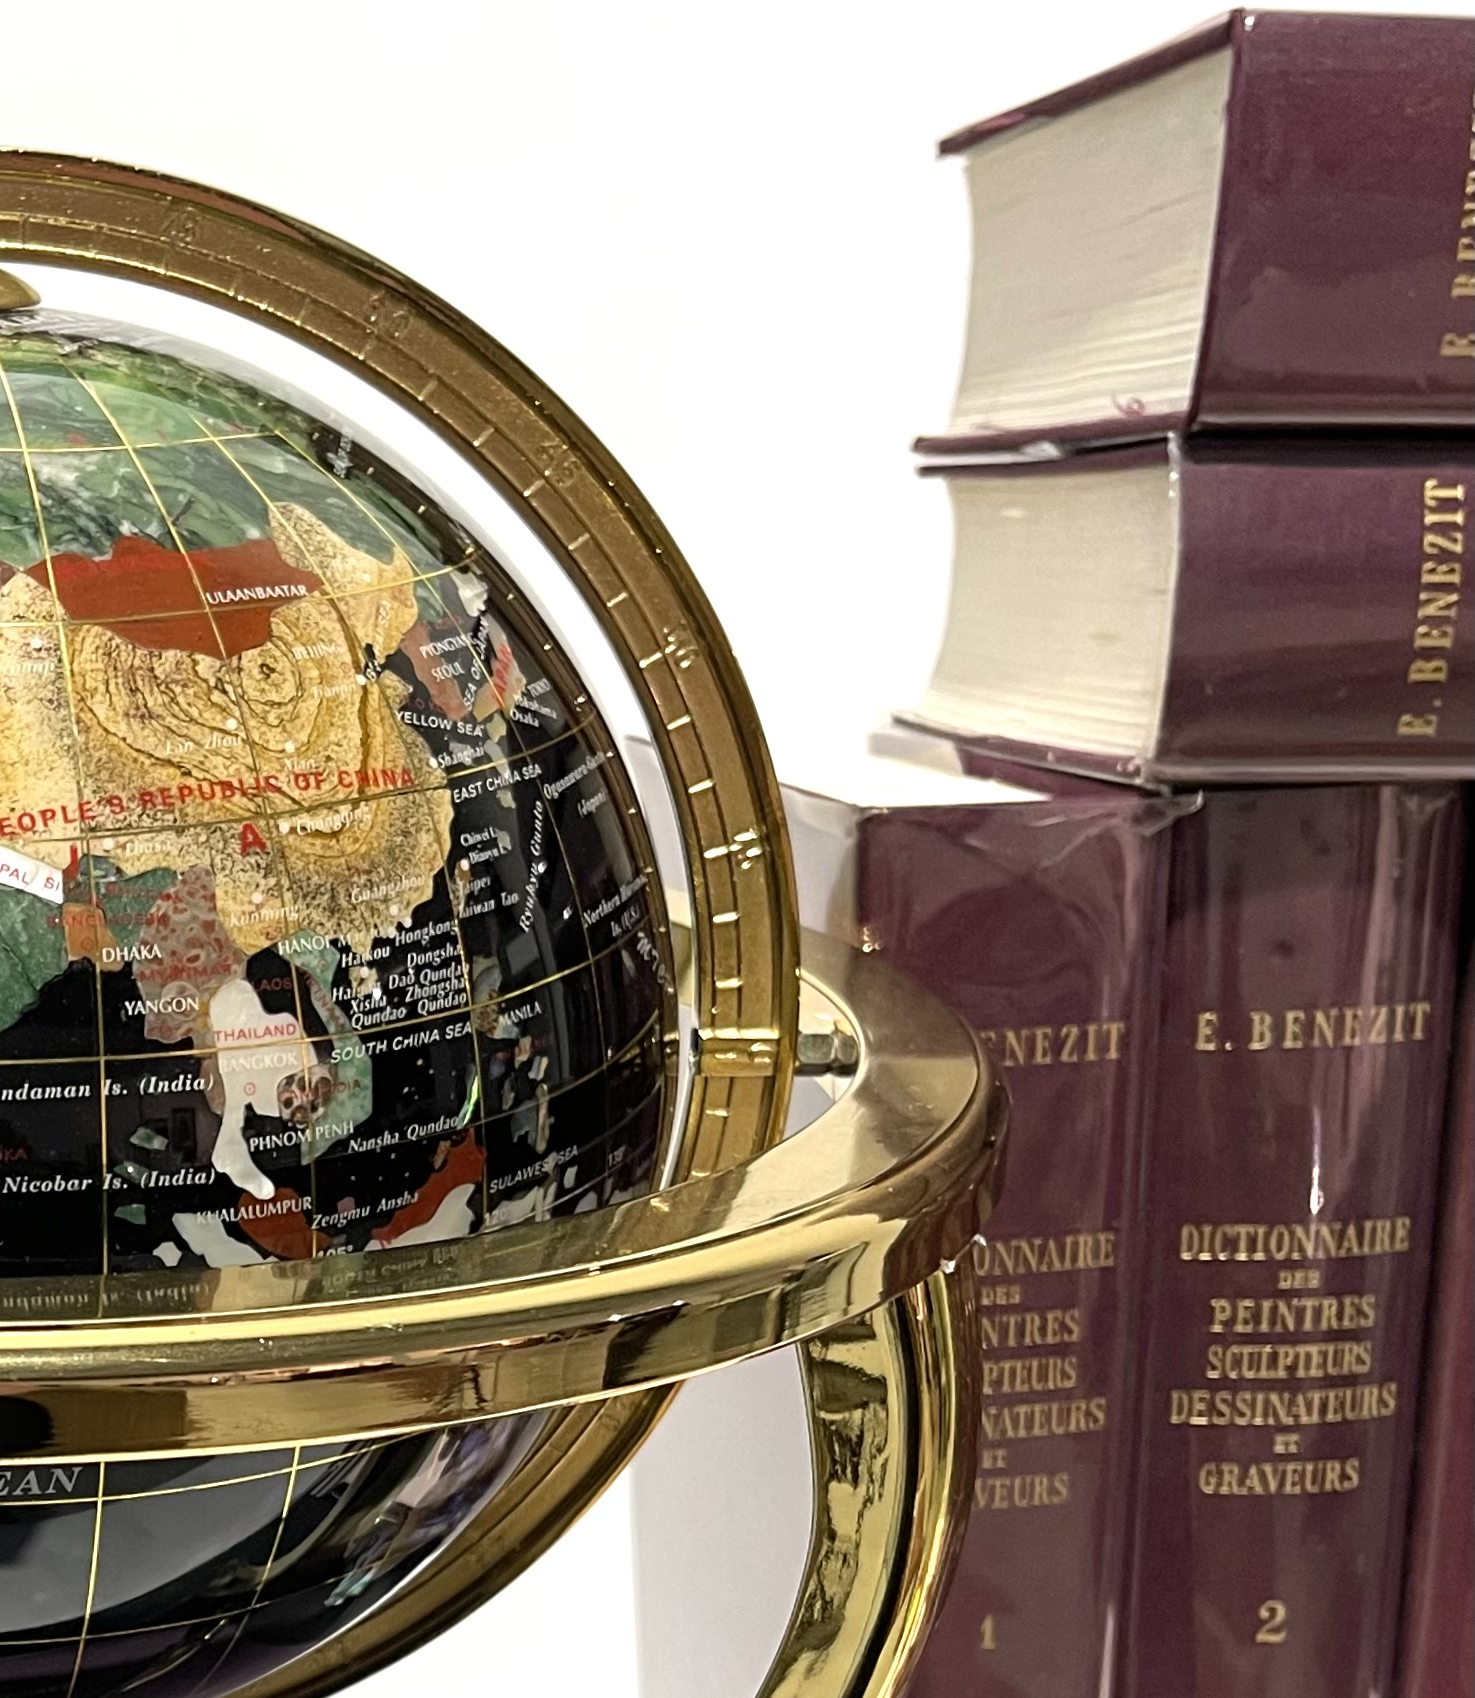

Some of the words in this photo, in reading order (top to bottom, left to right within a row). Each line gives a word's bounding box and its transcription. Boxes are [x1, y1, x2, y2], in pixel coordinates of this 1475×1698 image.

[206, 583, 310, 605] ULAANBAATAR
[1409, 478, 1469, 684] BENEZIT
[430, 663, 466, 683] SEOUL
[395, 710, 452, 731] YELLOW
[456, 720, 483, 738] SEA
[1397, 698, 1439, 739] E.
[437, 740, 485, 769] Shanghai
[137, 774, 279, 810] REPUBLIC
[293, 772, 327, 792] OF
[337, 766, 417, 789] CHINA
[453, 782, 483, 803] EAST
[522, 764, 543, 783] SEA
[101, 944, 164, 964] DHAKA
[277, 932, 332, 957] HANOI
[251, 976, 295, 993] LAOS
[124, 995, 200, 1017] YANGON
[351, 1006, 408, 1031] Qundao
[213, 1022, 299, 1043] THAILAND
[330, 1039, 388, 1064] SOUTH
[392, 1028, 441, 1051] CHINA
[444, 1020, 474, 1040] SEA
[1195, 1011, 1234, 1052] E.
[1247, 1003, 1431, 1049] BENEZIT
[103, 1078, 128, 1097] Is.
[138, 1073, 216, 1097] (India)
[248, 1128, 312, 1153] PHNOM
[314, 1119, 355, 1140] PENH
[347, 1129, 400, 1154] Nansha
[1, 1173, 93, 1194] Nicobar
[101, 1172, 129, 1190] Is.
[139, 1167, 218, 1189] (India)
[310, 1203, 371, 1231] Zengmu
[376, 1190, 420, 1215] Ansha
[1180, 1216, 1411, 1262] DICTIONNAIRE
[1209, 1295, 1377, 1334] PEINTRES
[1206, 1342, 1372, 1379] SCULPTEURS
[1170, 1383, 1399, 1427] DESSINATEURS
[1198, 1458, 1360, 1496] GRAVEURS
[979, 1614, 997, 1650] 1
[1255, 1599, 1289, 1644] 2
